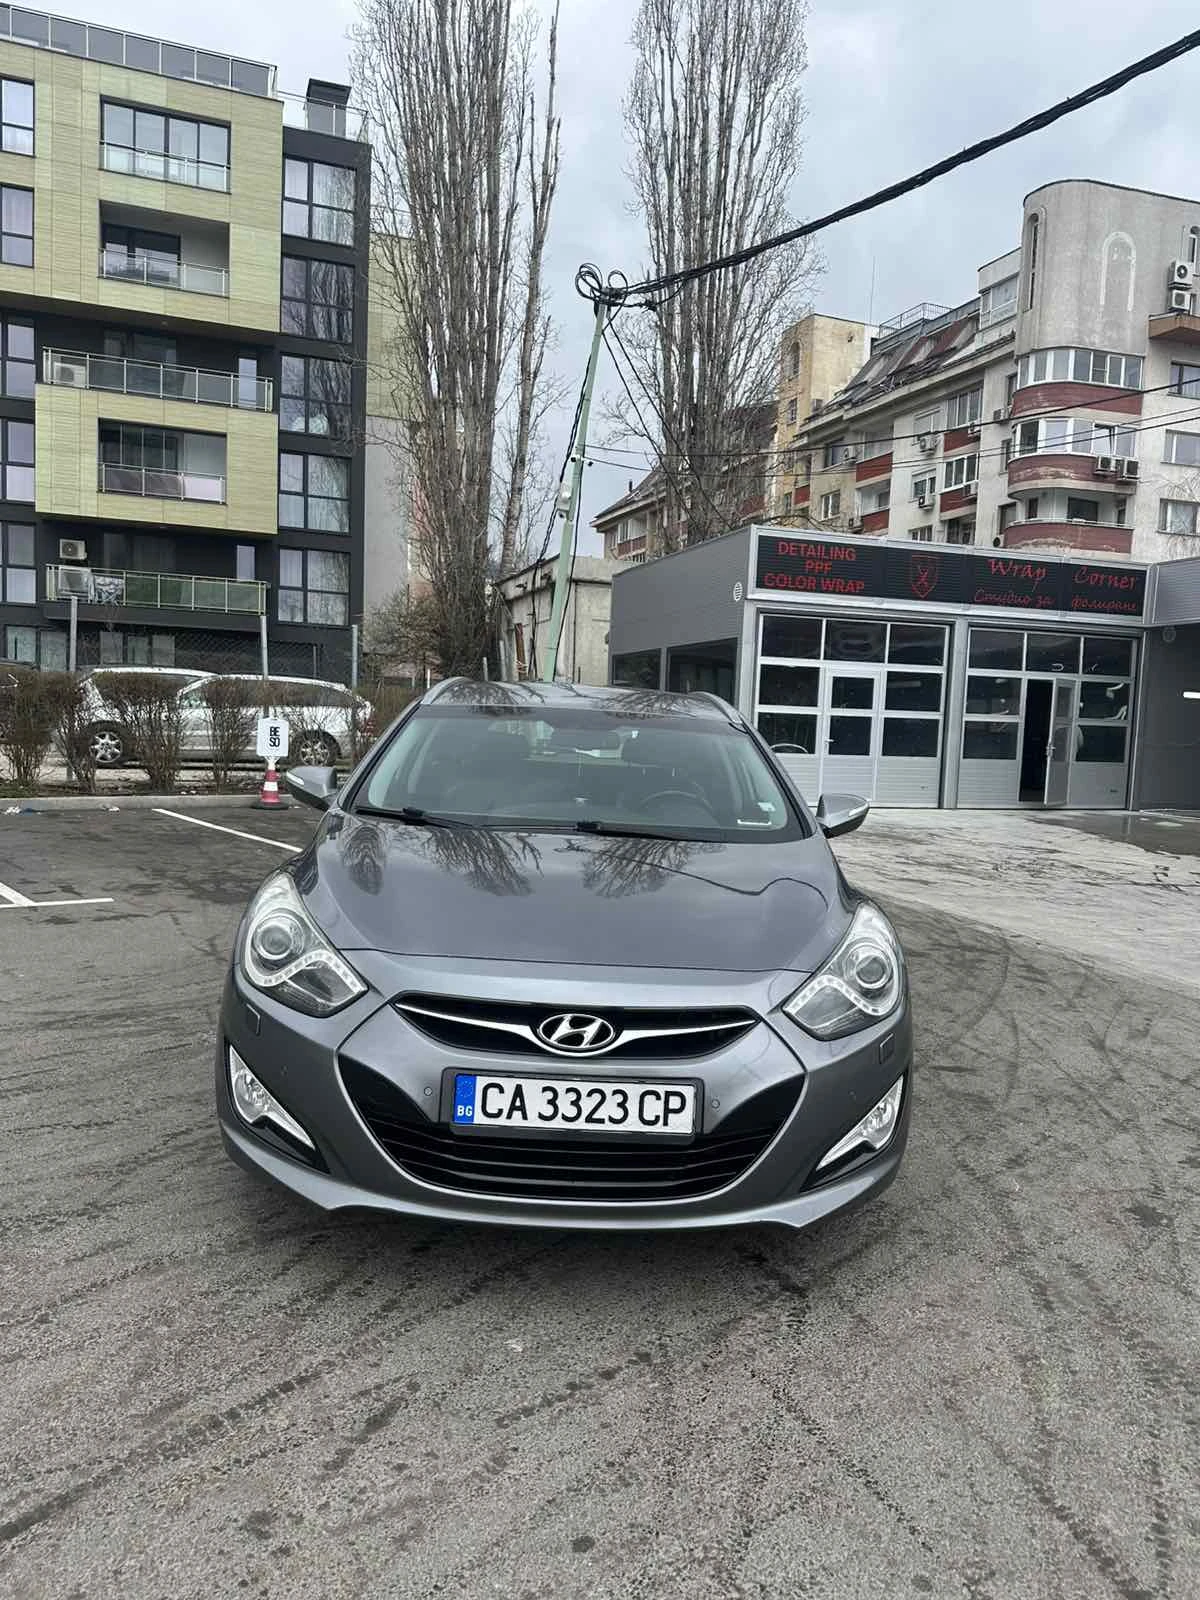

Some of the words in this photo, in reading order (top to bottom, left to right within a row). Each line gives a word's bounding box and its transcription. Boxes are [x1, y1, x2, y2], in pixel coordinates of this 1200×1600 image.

[778, 542, 856, 560] DETAILING
[805, 561, 832, 574] PPF
[988, 559, 1047, 592] Wrap
[1074, 566, 1136, 587] Corner
[764, 573, 817, 590] COLOR
[822, 578, 865, 592] WRAP
[269, 726, 280, 736] BE
[457, 1105, 473, 1117] BG
[481, 1083, 528, 1120] CA
[537, 1086, 629, 1125] 3323
[638, 1089, 686, 1126] CP
